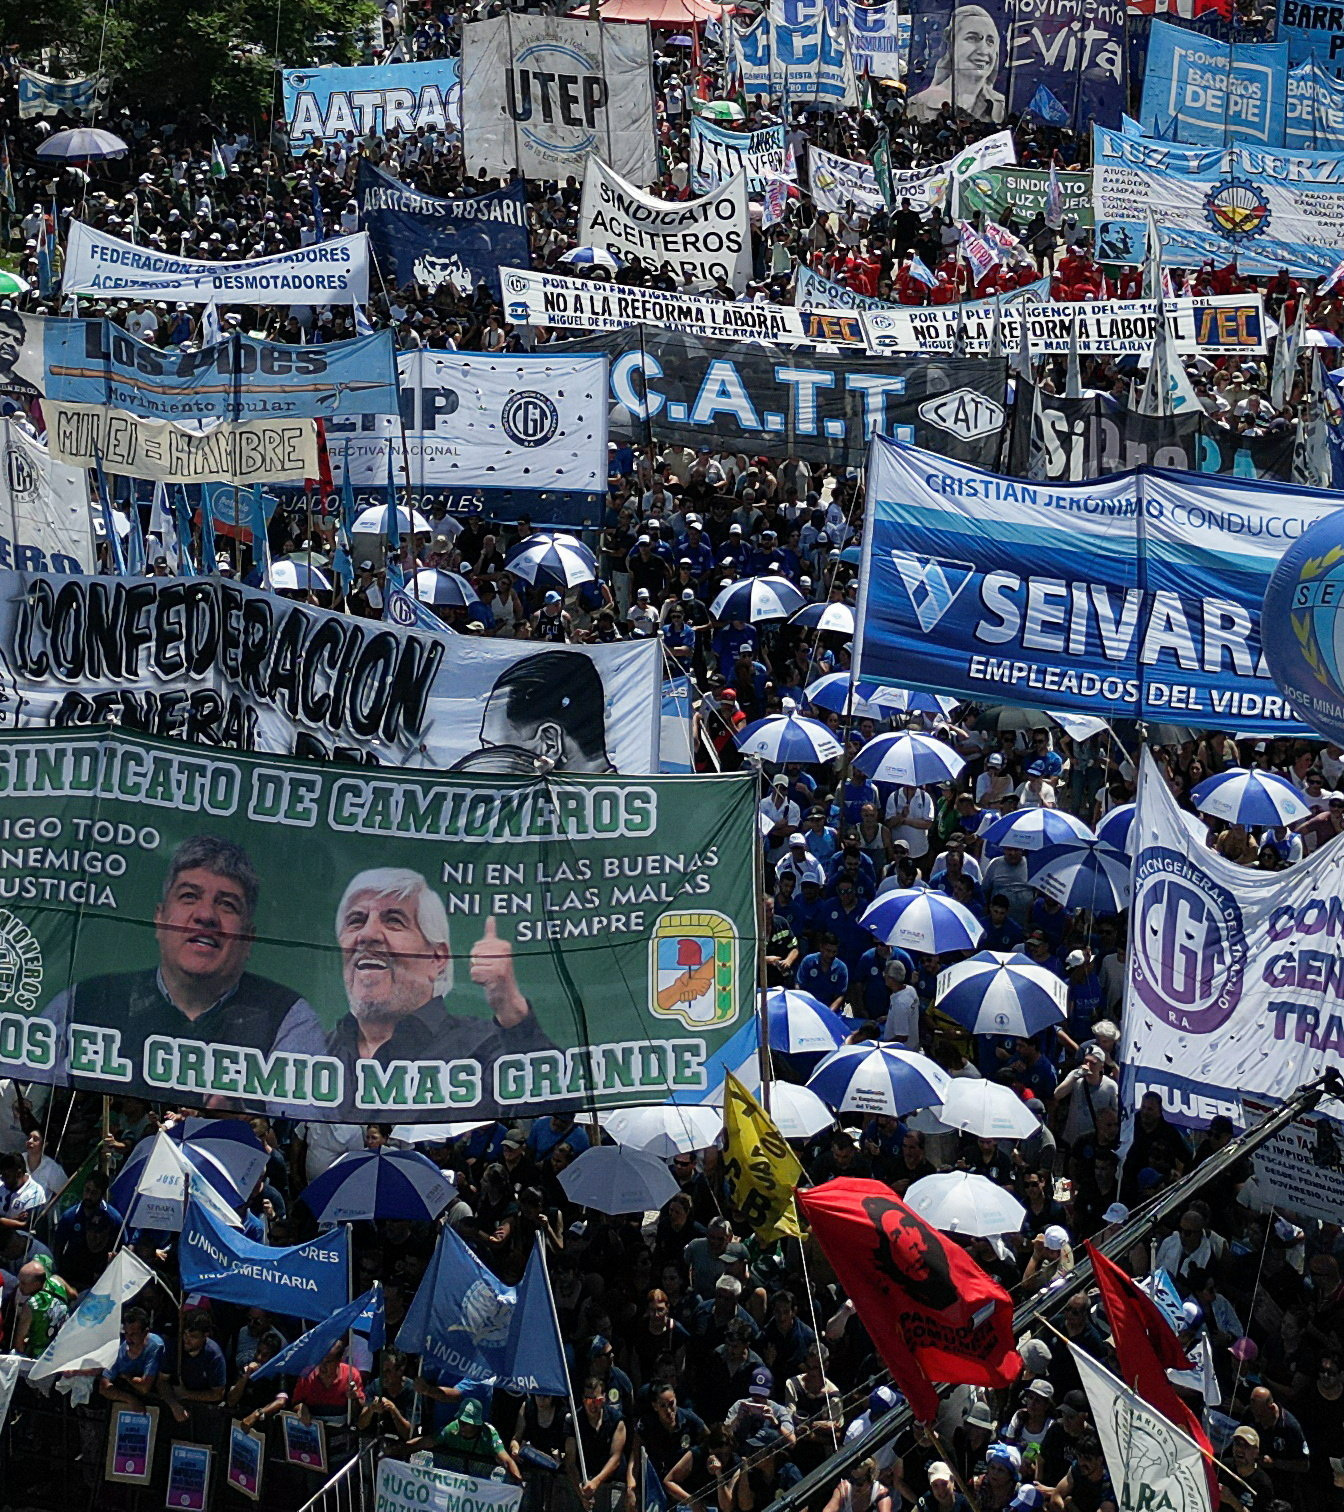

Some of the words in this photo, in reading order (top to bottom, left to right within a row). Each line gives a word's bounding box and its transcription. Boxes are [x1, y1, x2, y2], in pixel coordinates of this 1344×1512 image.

[505, 68, 610, 129] UTEP
[1187, 68, 1261, 96] BARRIOS
[1186, 86, 1224, 113] DE
[1229, 98, 1261, 123] PIE
[1102, 134, 1170, 172] LUZ
[1182, 151, 1206, 174] Y
[600, 181, 736, 226] SINDICATO
[590, 210, 743, 255] ACEITEROS
[212, 274, 348, 289] DESMOTADORES
[544, 293, 568, 313] NO
[573, 295, 585, 315] A
[590, 296, 612, 317] LA
[619, 299, 705, 325] REFORMA
[711, 308, 792, 335] LABORAL
[934, 396, 996, 432] CATT
[56, 410, 138, 466] MILEI
[168, 427, 305, 477] HAMBRE
[391, 445, 462, 457] NACIONAL
[17, 578, 445, 746] CONFEDERACION
[969, 655, 1140, 703] EMPLEADOS
[1149, 683, 1204, 710] DEL
[1210, 689, 1304, 724] VIDRI
[1283, 684, 1311, 707] JOSE
[248, 768, 321, 828] DE
[329, 777, 657, 843] CAMIONEROS
[72, 818, 161, 850] TODO
[442, 861, 474, 885] NI
[485, 861, 525, 886] EN
[535, 857, 593, 884] LAS
[602, 846, 720, 879] BUENAS
[448, 893, 480, 916] NI
[492, 892, 533, 915] EN
[544, 887, 601, 913] LAS
[609, 875, 712, 907] MALAS
[515, 911, 646, 943] SIEMPRE
[67, 1024, 133, 1083] EL
[142, 1034, 345, 1108] GREMIO
[356, 1058, 482, 1110] MAS
[493, 1039, 707, 1105] GRANDE
[187, 1230, 229, 1267] UNION
